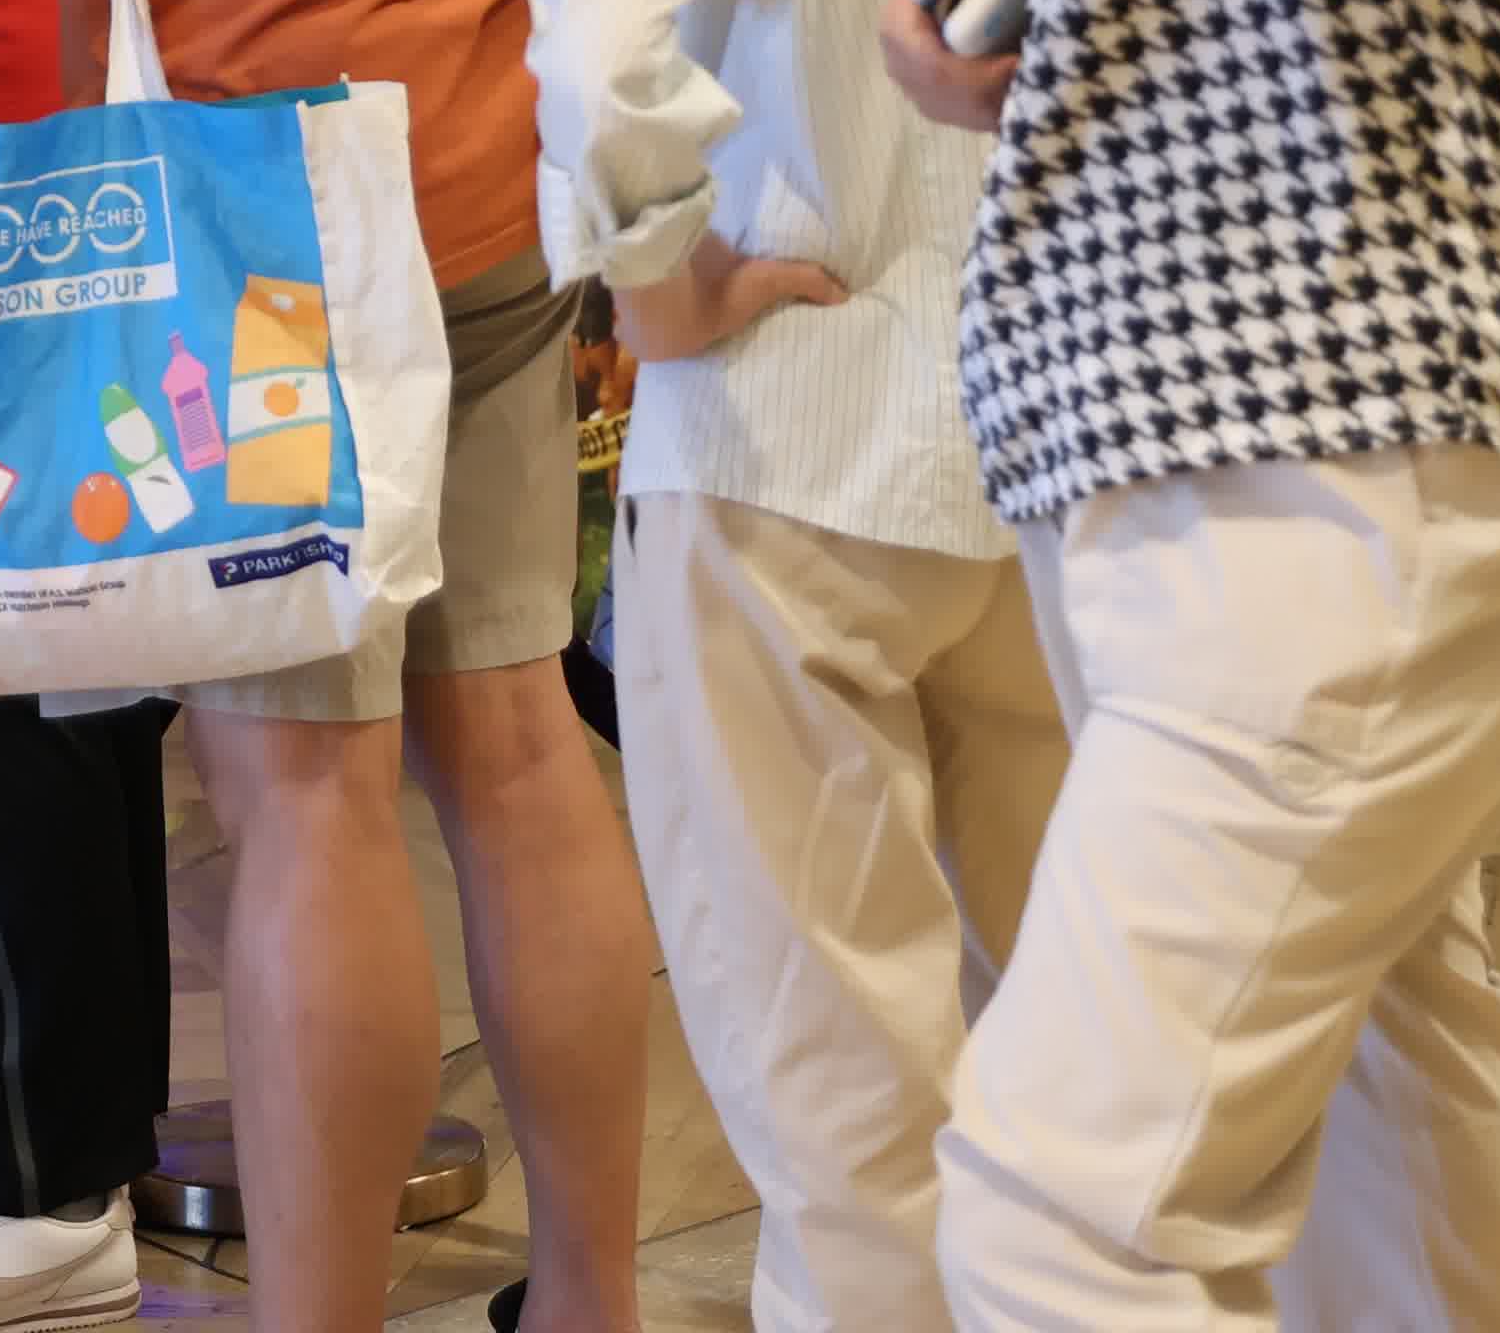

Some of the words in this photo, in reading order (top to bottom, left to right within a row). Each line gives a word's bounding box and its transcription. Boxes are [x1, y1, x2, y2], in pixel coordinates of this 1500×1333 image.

[16, 219, 52, 246] HAVE
[58, 206, 147, 237] REACHED
[56, 273, 147, 308] GROUP
